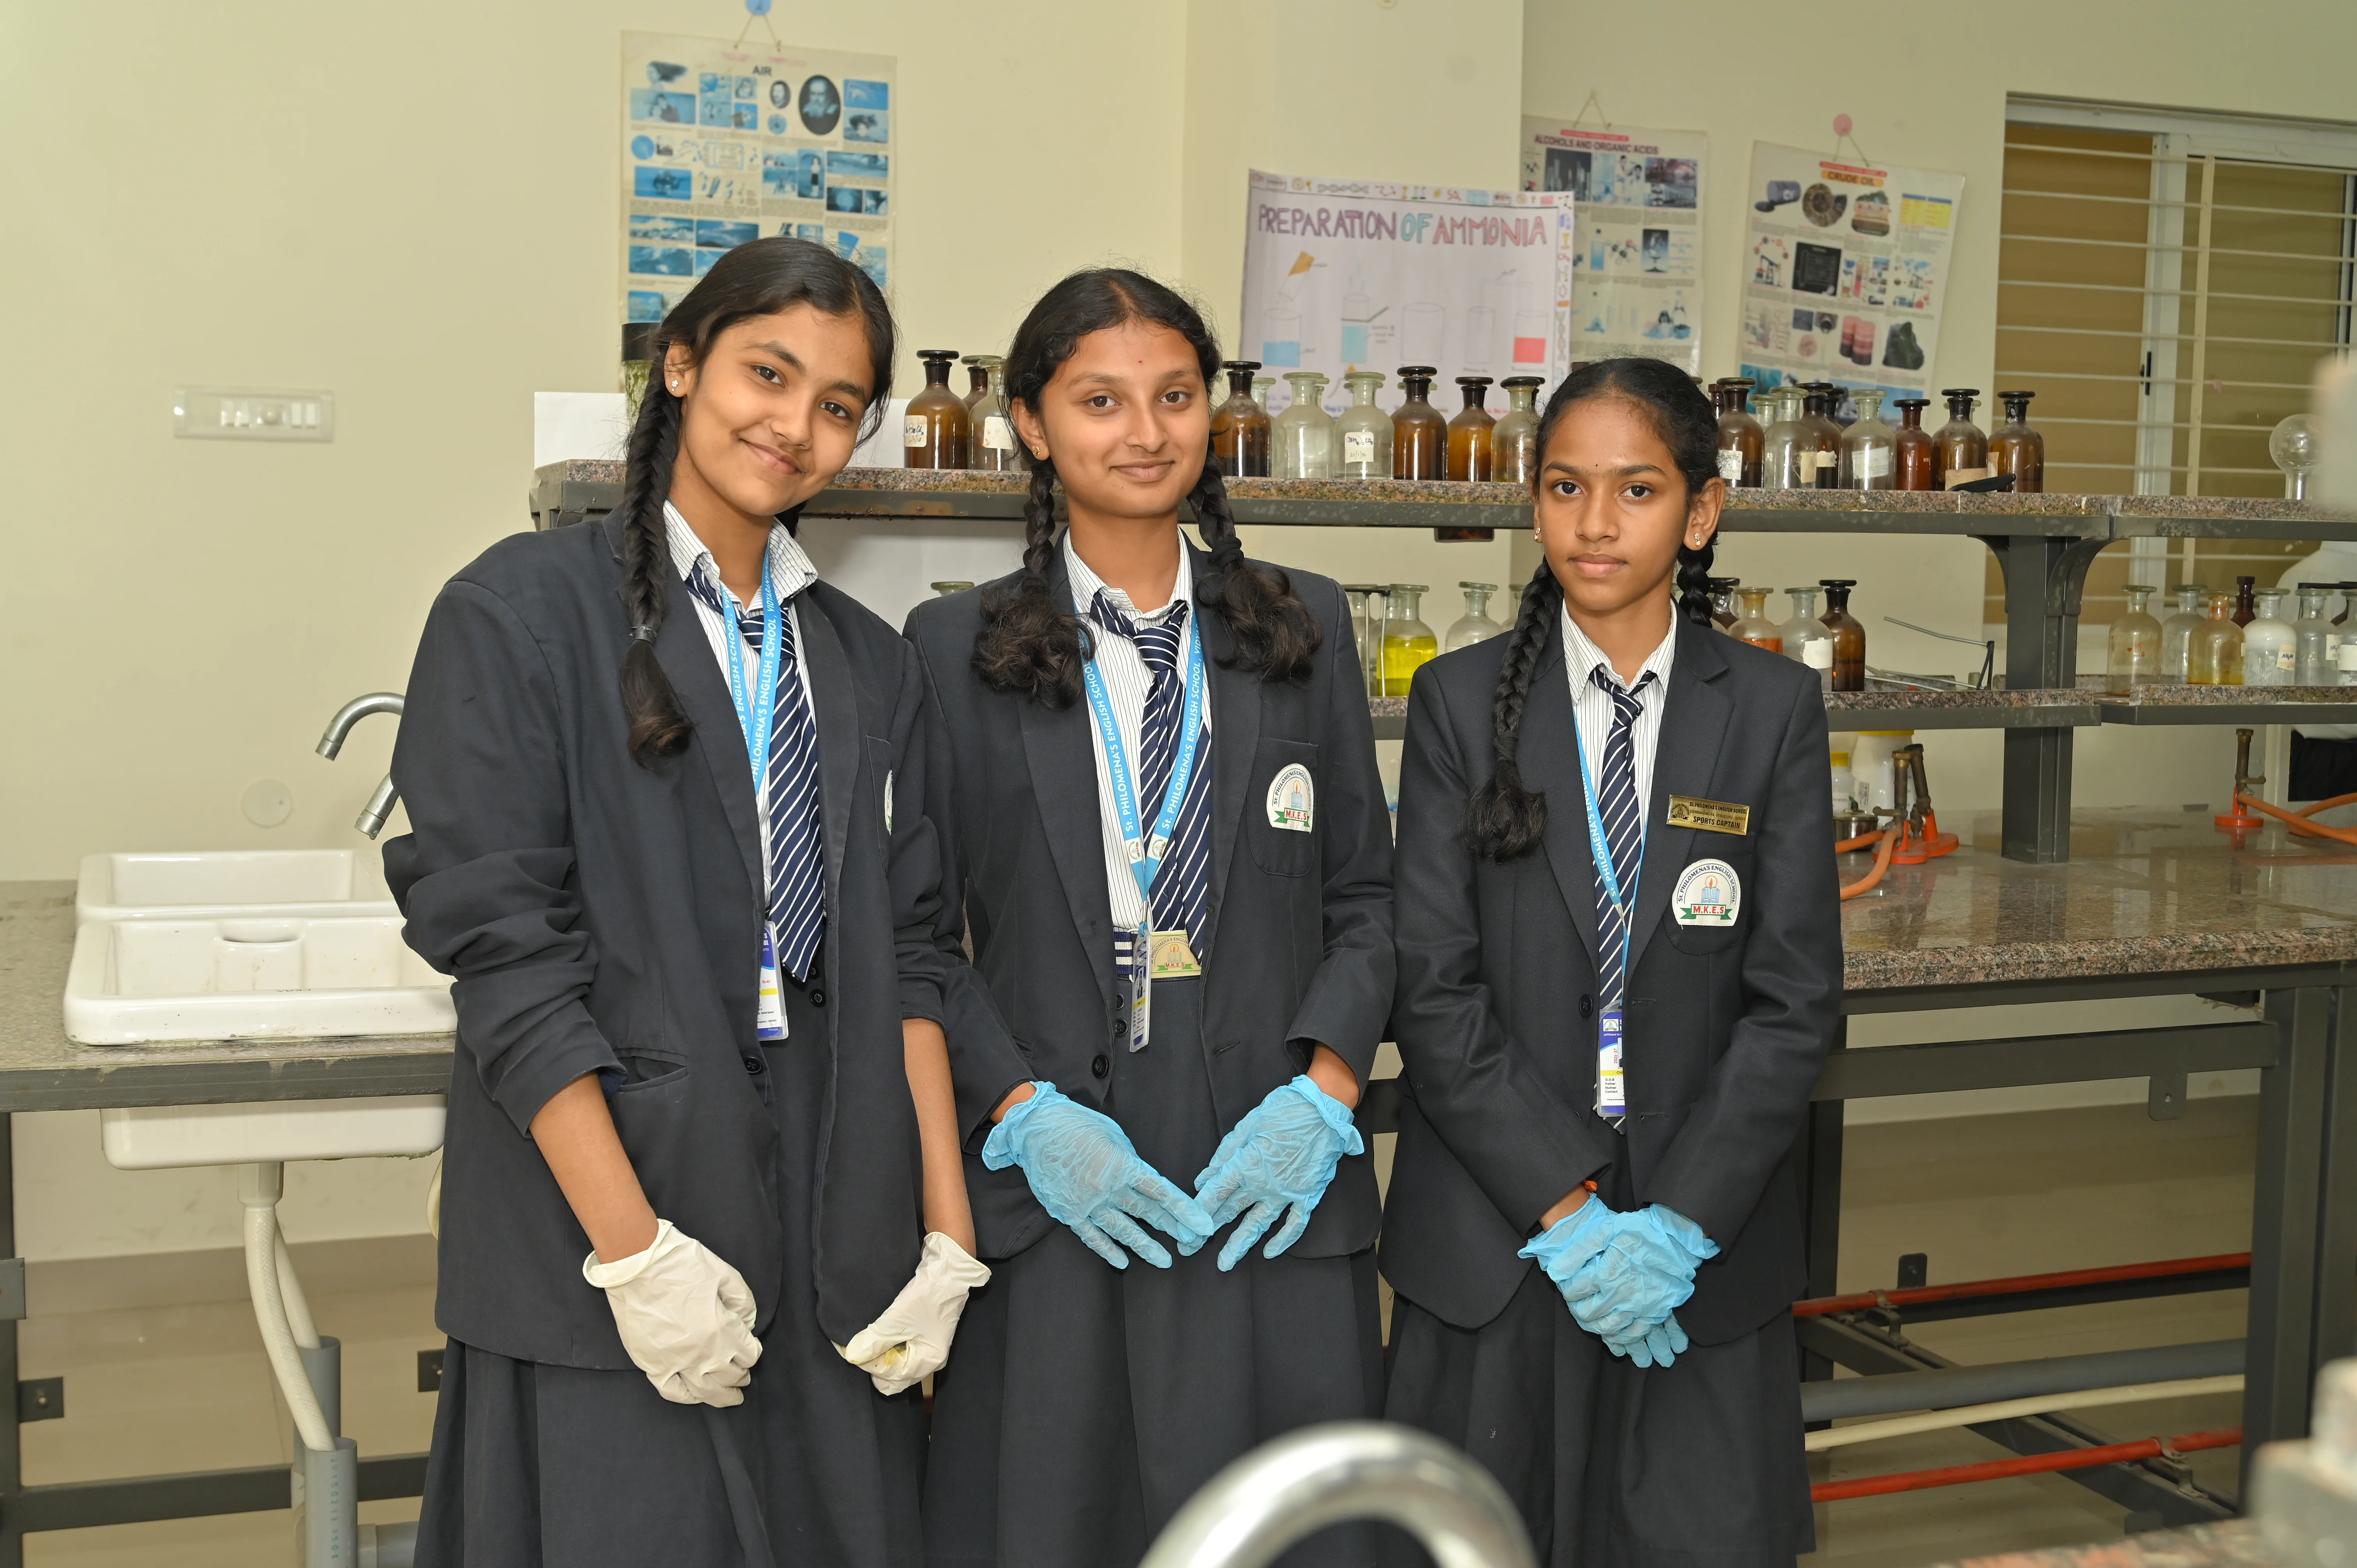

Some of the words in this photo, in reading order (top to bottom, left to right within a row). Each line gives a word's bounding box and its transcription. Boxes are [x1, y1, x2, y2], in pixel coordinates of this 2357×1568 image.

[753, 65, 772, 76] AIR
[1535, 134, 1574, 147] ALCOHOLS
[1576, 140, 1591, 149] AND
[1594, 142, 1632, 153] ORGANIC
[1633, 145, 1659, 155] ACIDS
[1828, 171, 1857, 184] CRUDE
[1861, 177, 1875, 186] OIL
[1258, 203, 1397, 240] PREPARATION
[1401, 213, 1433, 243] OF
[1433, 215, 1547, 247] AMMONIA
[728, 613, 738, 662] SCHOOL,
[765, 615, 777, 658] SCHOOL,
[732, 664, 744, 712] ENGLISH
[759, 659, 773, 705] ENGLISH
[1191, 659, 1201, 699] SCHOOL,
[1097, 701, 1116, 742] ENGLISH
[1187, 701, 1198, 742] ENGLISH
[1110, 744, 1131, 815] PHILOMENA'S
[1167, 744, 1193, 814] PHILOMENA'S
[1275, 770, 1296, 796] PHILOMENA'S
[1125, 818, 1134, 832] St.
[1161, 818, 1172, 830] St.
[1286, 809, 1306, 820] M.K.E.S
[1693, 816, 1715, 825] SPORTS
[1716, 819, 1740, 829] CAPTAIN
[1588, 813, 1612, 882] PHILOMENA'S
[1680, 865, 1710, 893] PHILOMENA'S
[1711, 865, 1731, 879] ENGLISH
[1693, 906, 1724, 914] M.K.E.S
